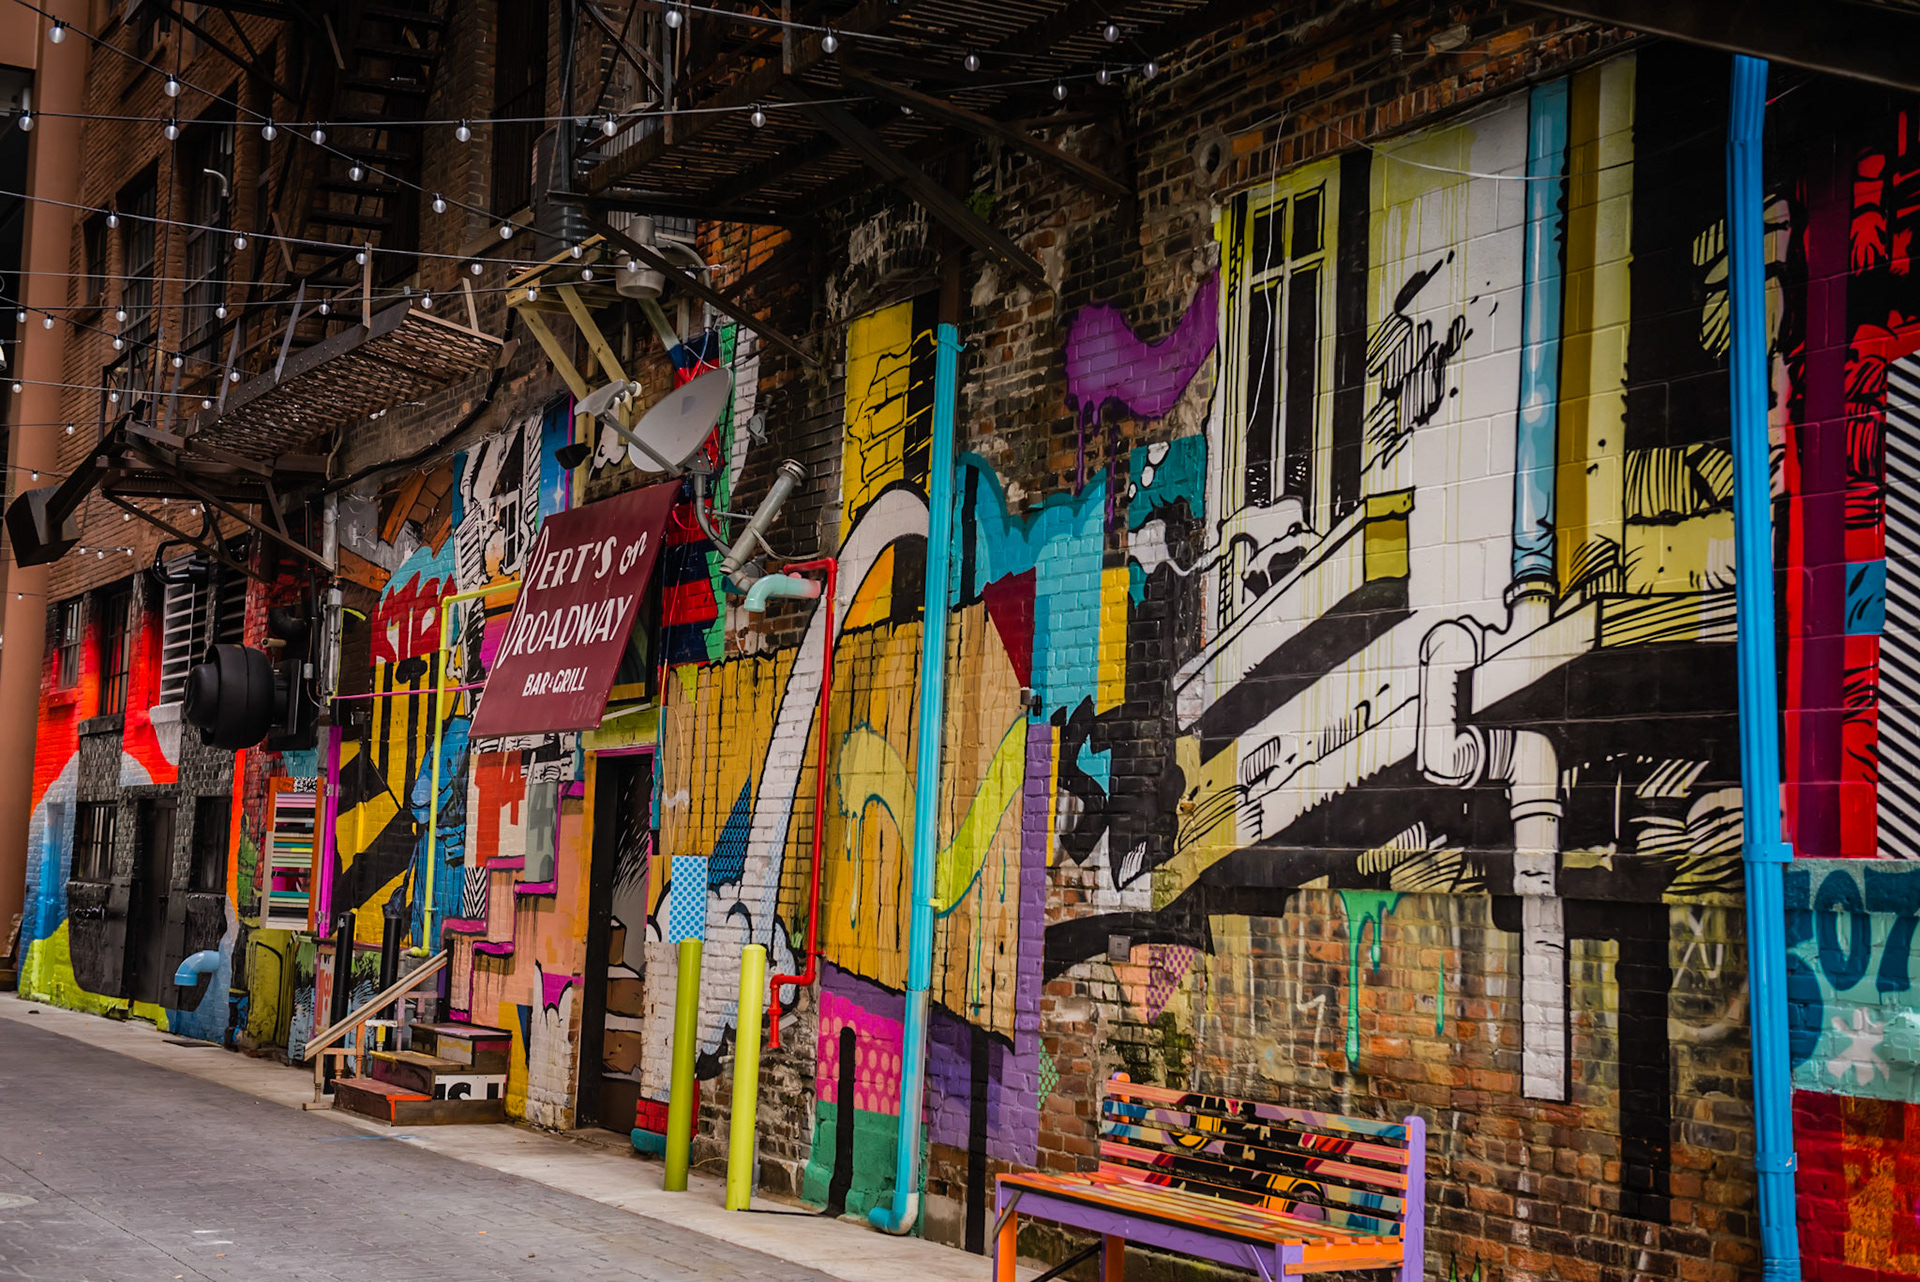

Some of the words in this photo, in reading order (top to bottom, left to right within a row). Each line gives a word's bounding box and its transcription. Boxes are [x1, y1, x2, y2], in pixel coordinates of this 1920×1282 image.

[619, 531, 647, 575] on
[522, 672, 551, 696] BAR
[552, 666, 588, 694] GRILL
